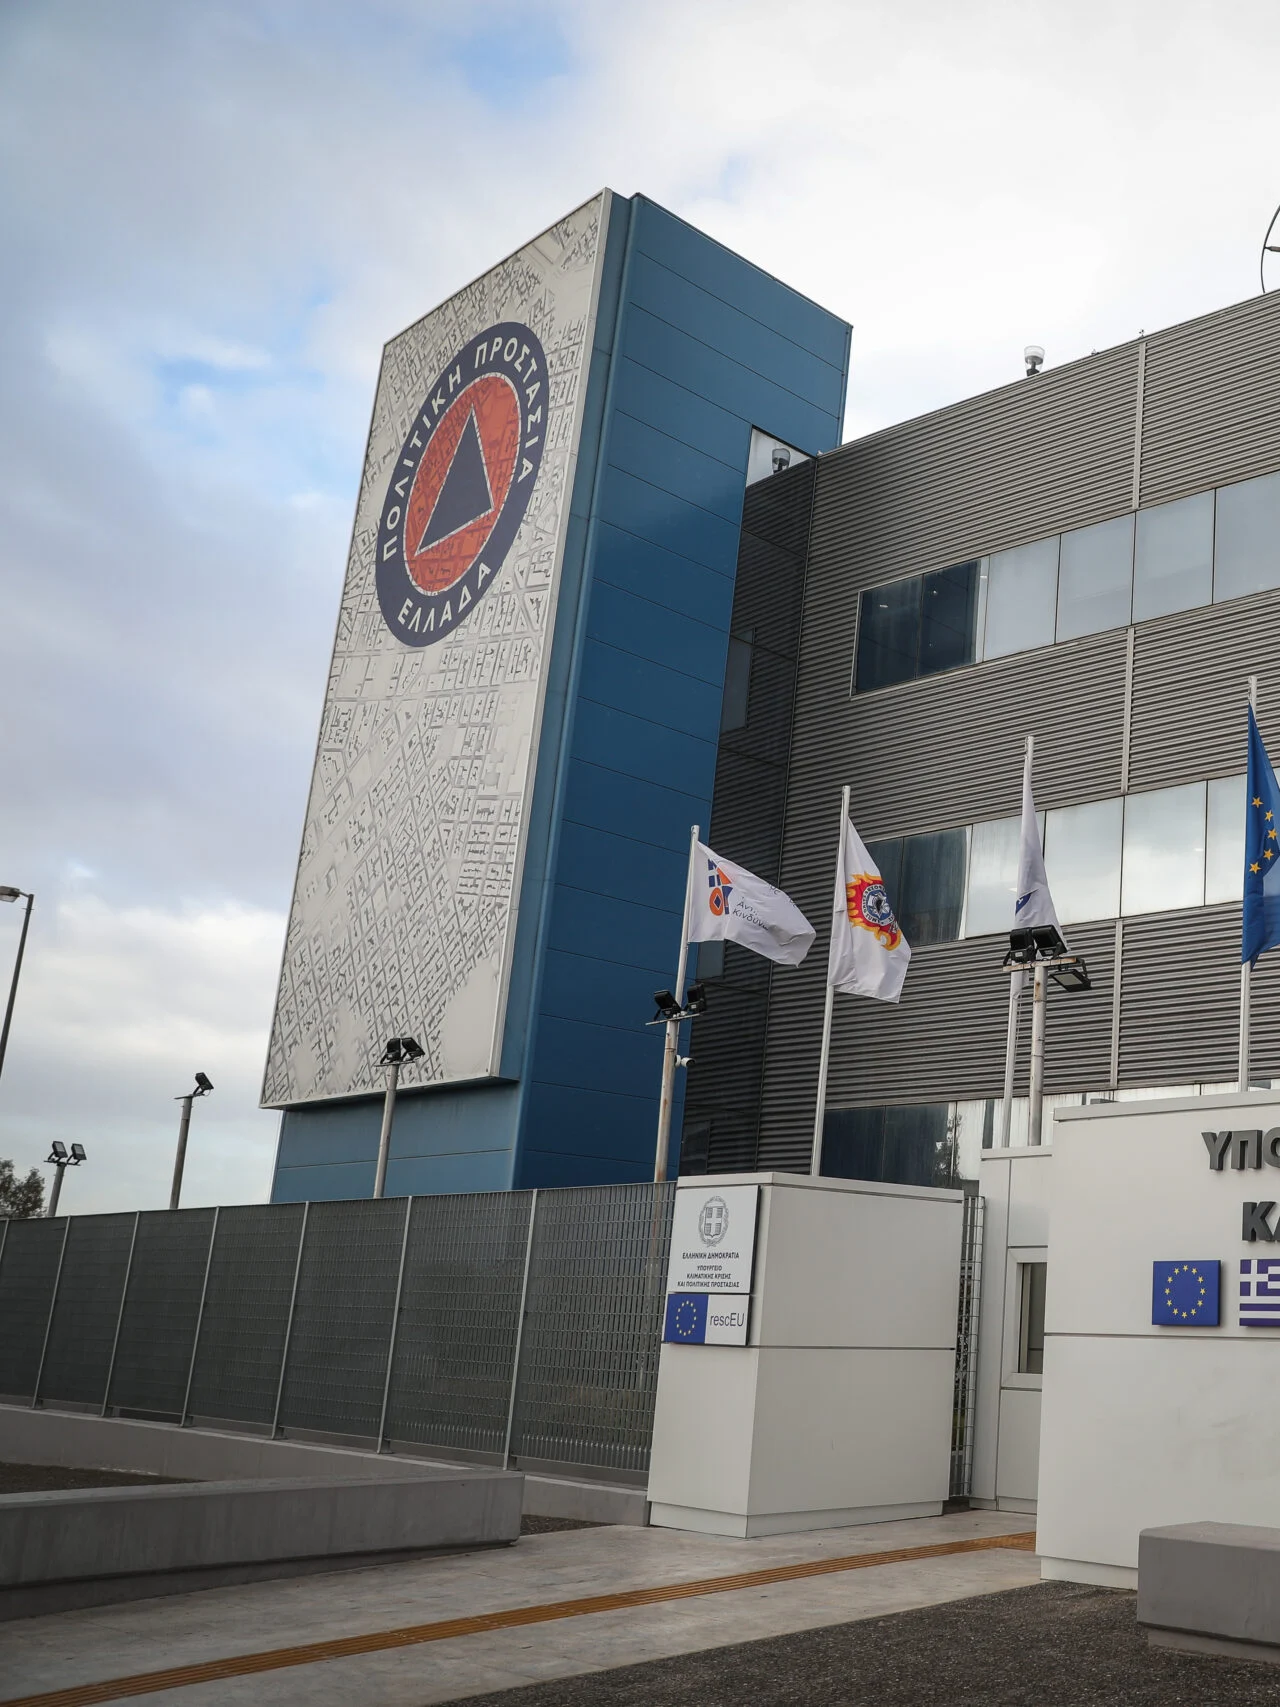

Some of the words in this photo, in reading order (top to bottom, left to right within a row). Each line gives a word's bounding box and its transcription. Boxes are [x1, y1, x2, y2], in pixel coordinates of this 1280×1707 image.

[383, 364, 462, 561] ΠΟΛΙΤΙΚΗ
[474, 336, 542, 484] ΠΡΟΣΤΑΣΙΑ
[397, 561, 492, 634] ΕΛΛΑΔΑ
[682, 1252, 707, 1260] ΕΛΛΗΝΙΚΗ
[707, 1252, 740, 1260] ΔΗΜΟΚΡΑΤΙΑ
[709, 1312, 745, 1327] rescEU
